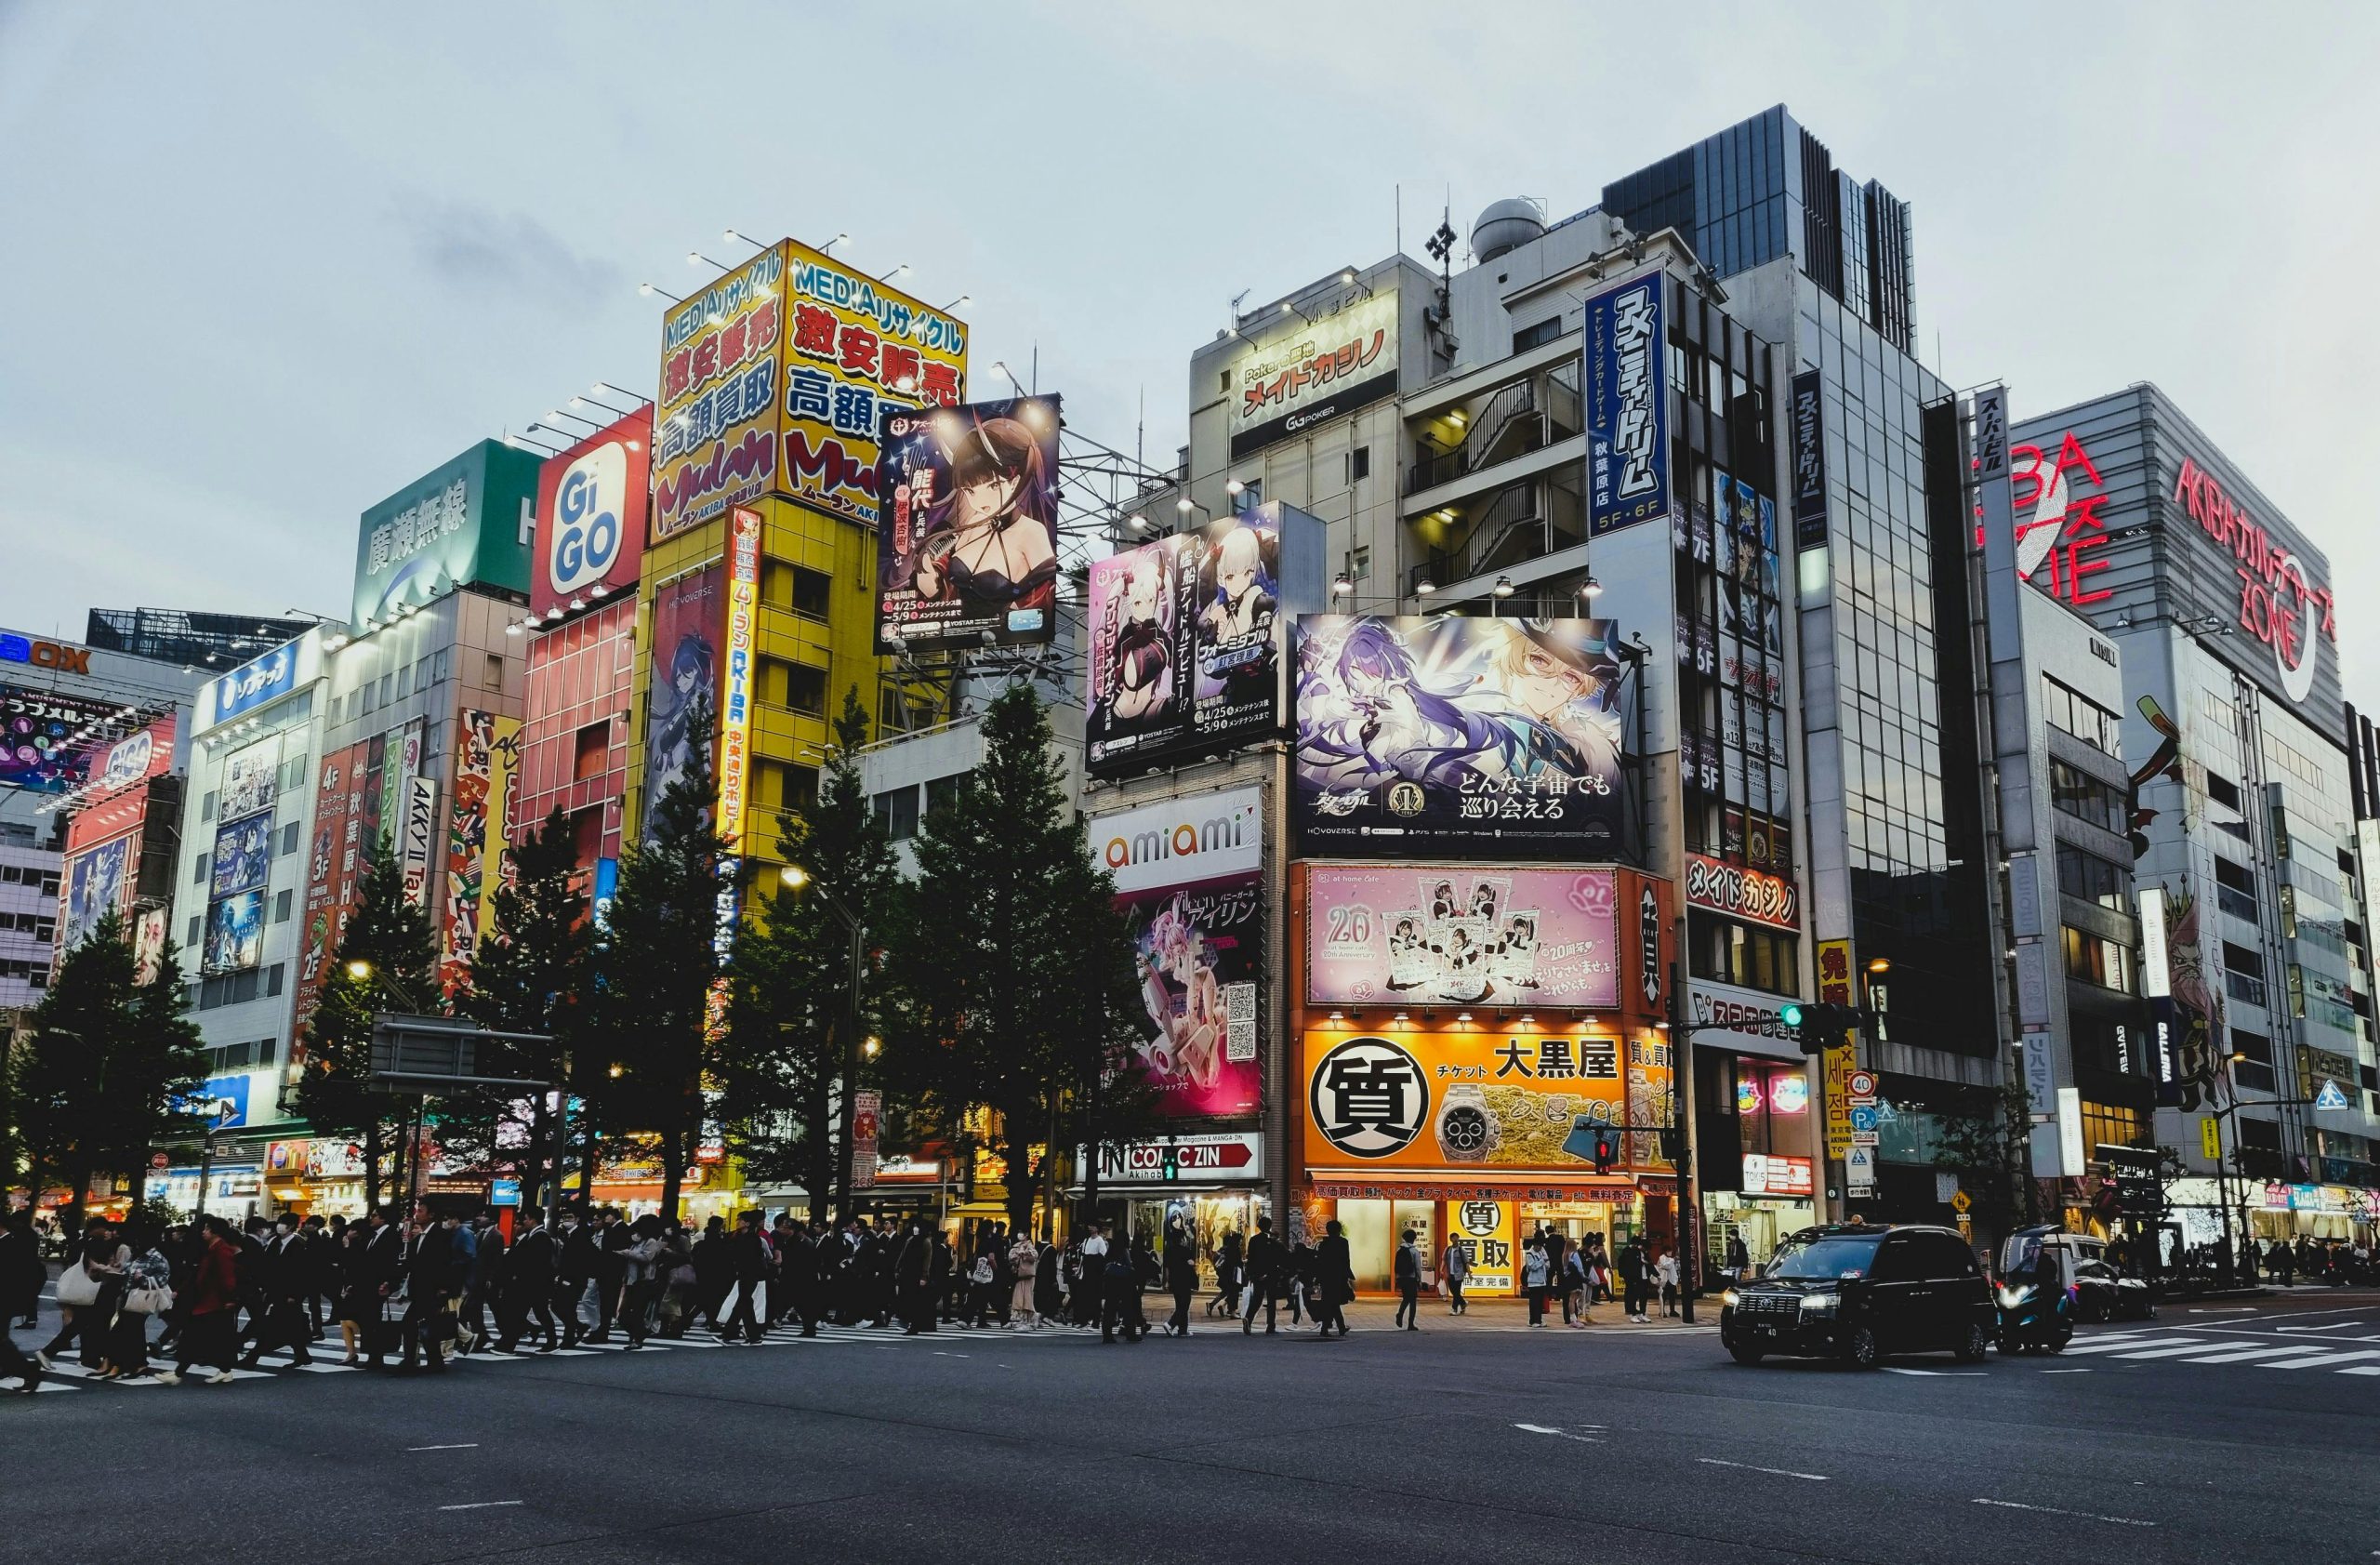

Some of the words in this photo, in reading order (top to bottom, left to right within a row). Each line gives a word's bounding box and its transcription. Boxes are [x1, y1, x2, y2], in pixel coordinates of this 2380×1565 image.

[665, 299, 777, 404] 激安販売
[794, 304, 959, 407] 激安販売
[1243, 329, 1384, 418] メイドカジノ
[660, 359, 774, 465] 高額買取
[656, 431, 774, 531] Mulan
[1594, 441, 1610, 508] 秋葉原店
[911, 468, 935, 511] 能代
[556, 511, 616, 583] GO
[1692, 535, 1711, 564] 7F
[892, 601, 917, 611] 4/25
[1697, 646, 1714, 674] 6F
[1205, 707, 1226, 721] 4/25
[322, 764, 339, 790] 4F
[1459, 773, 1611, 796] どんな宇宙でも
[1700, 763, 1719, 791] 5F
[410, 780, 430, 845] AKKY
[1460, 796, 1565, 820] 巡り会える
[343, 790, 362, 872] 秋葉原
[1106, 814, 1242, 868] amiami
[1307, 827, 1357, 835] HOYOVERSE
[312, 855, 330, 882] 3F
[1688, 859, 1796, 924] メイドカジノ
[1186, 901, 1257, 931] アイリン
[1328, 906, 1371, 944] 20
[302, 953, 320, 981] 2F
[1339, 950, 1375, 960] Anniversary
[1495, 1038, 1619, 1080] 大黒屋
[2157, 1021, 2172, 1083] GALLERIA
[1437, 1064, 1488, 1079] チケット
[1855, 1079, 1870, 1091] 40
[1324, 1054, 1418, 1144] 質
[1183, 1135, 1207, 1144] Magazine
[1130, 1146, 1190, 1168] COC
[1194, 1147, 1220, 1167] ZIN
[1316, 1186, 1360, 1197] 高価買取
[1590, 1189, 1634, 1200] 無料査定
[1465, 1201, 1496, 1231] 質
[1457, 1239, 1511, 1268] 買取
